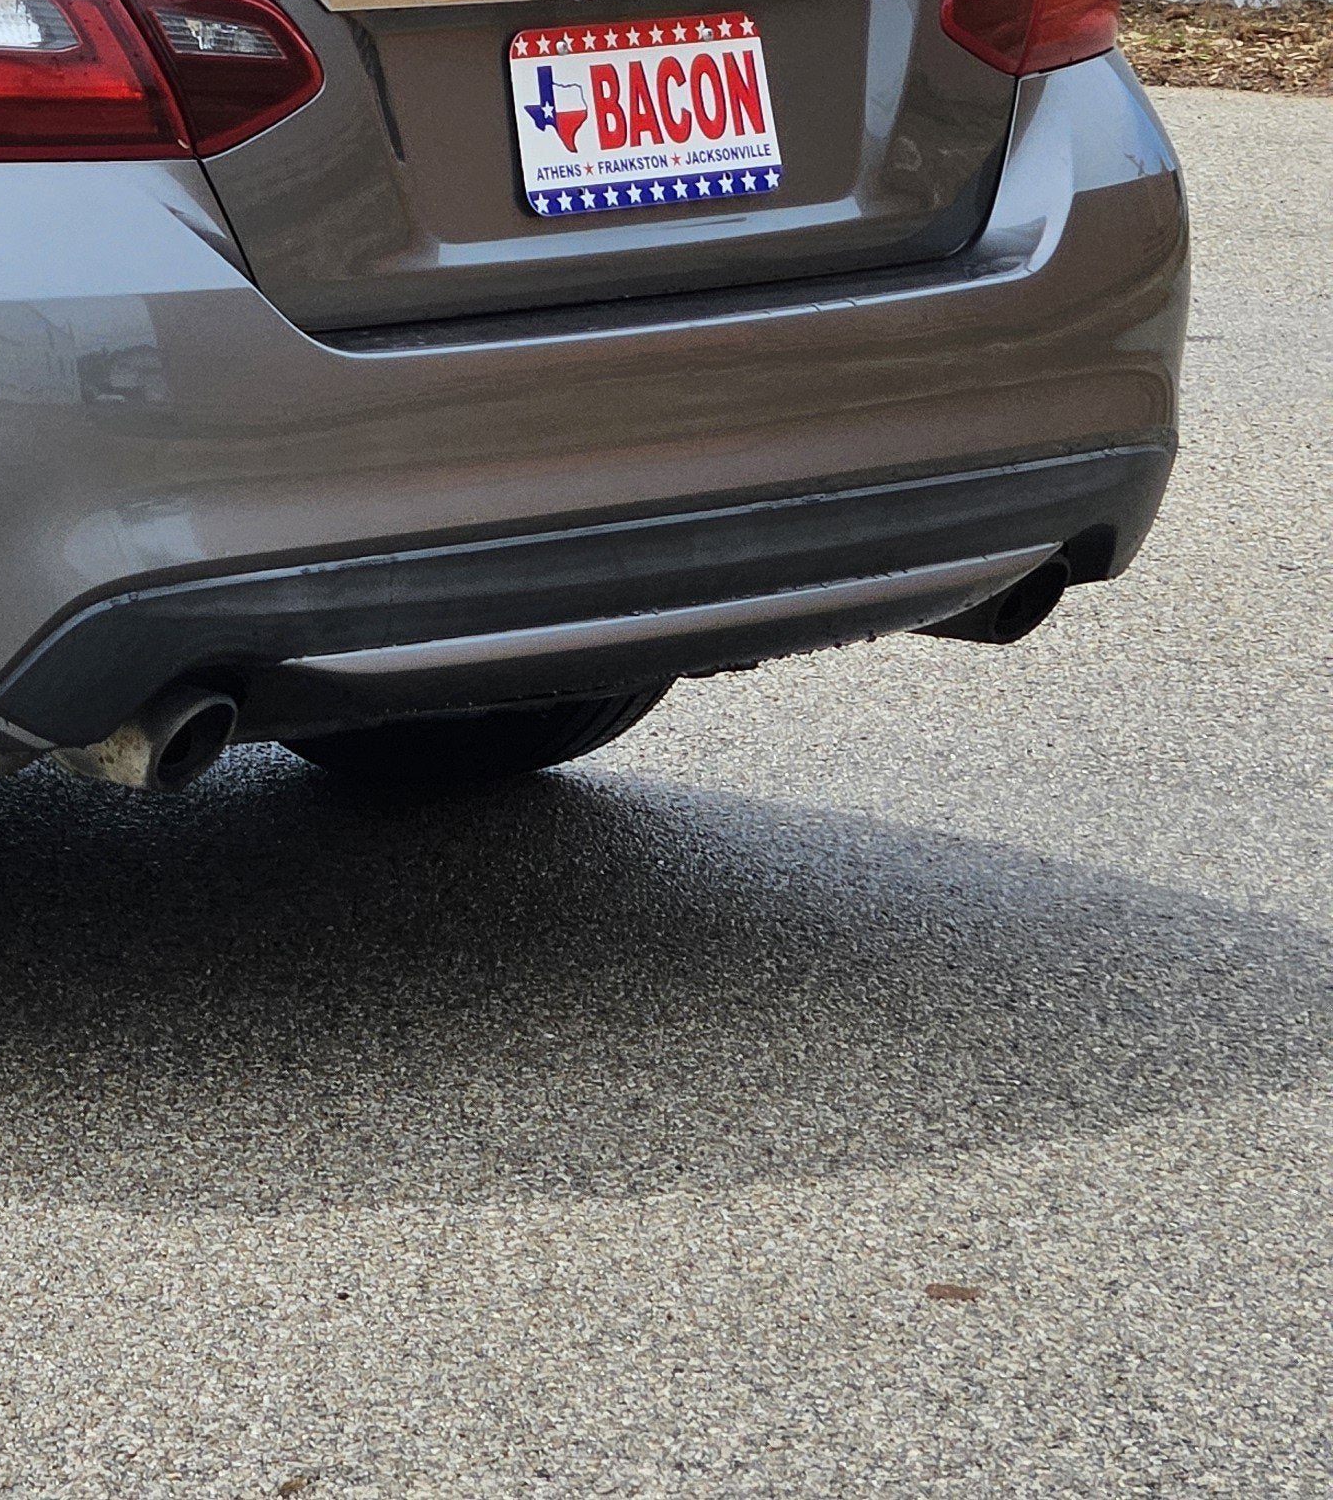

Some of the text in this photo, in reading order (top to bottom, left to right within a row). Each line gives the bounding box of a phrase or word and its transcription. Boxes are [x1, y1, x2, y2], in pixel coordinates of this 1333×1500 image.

[589, 50, 766, 150] BACON
[536, 143, 772, 181] ATHENS FRANKSTON JACKSONVILLE
